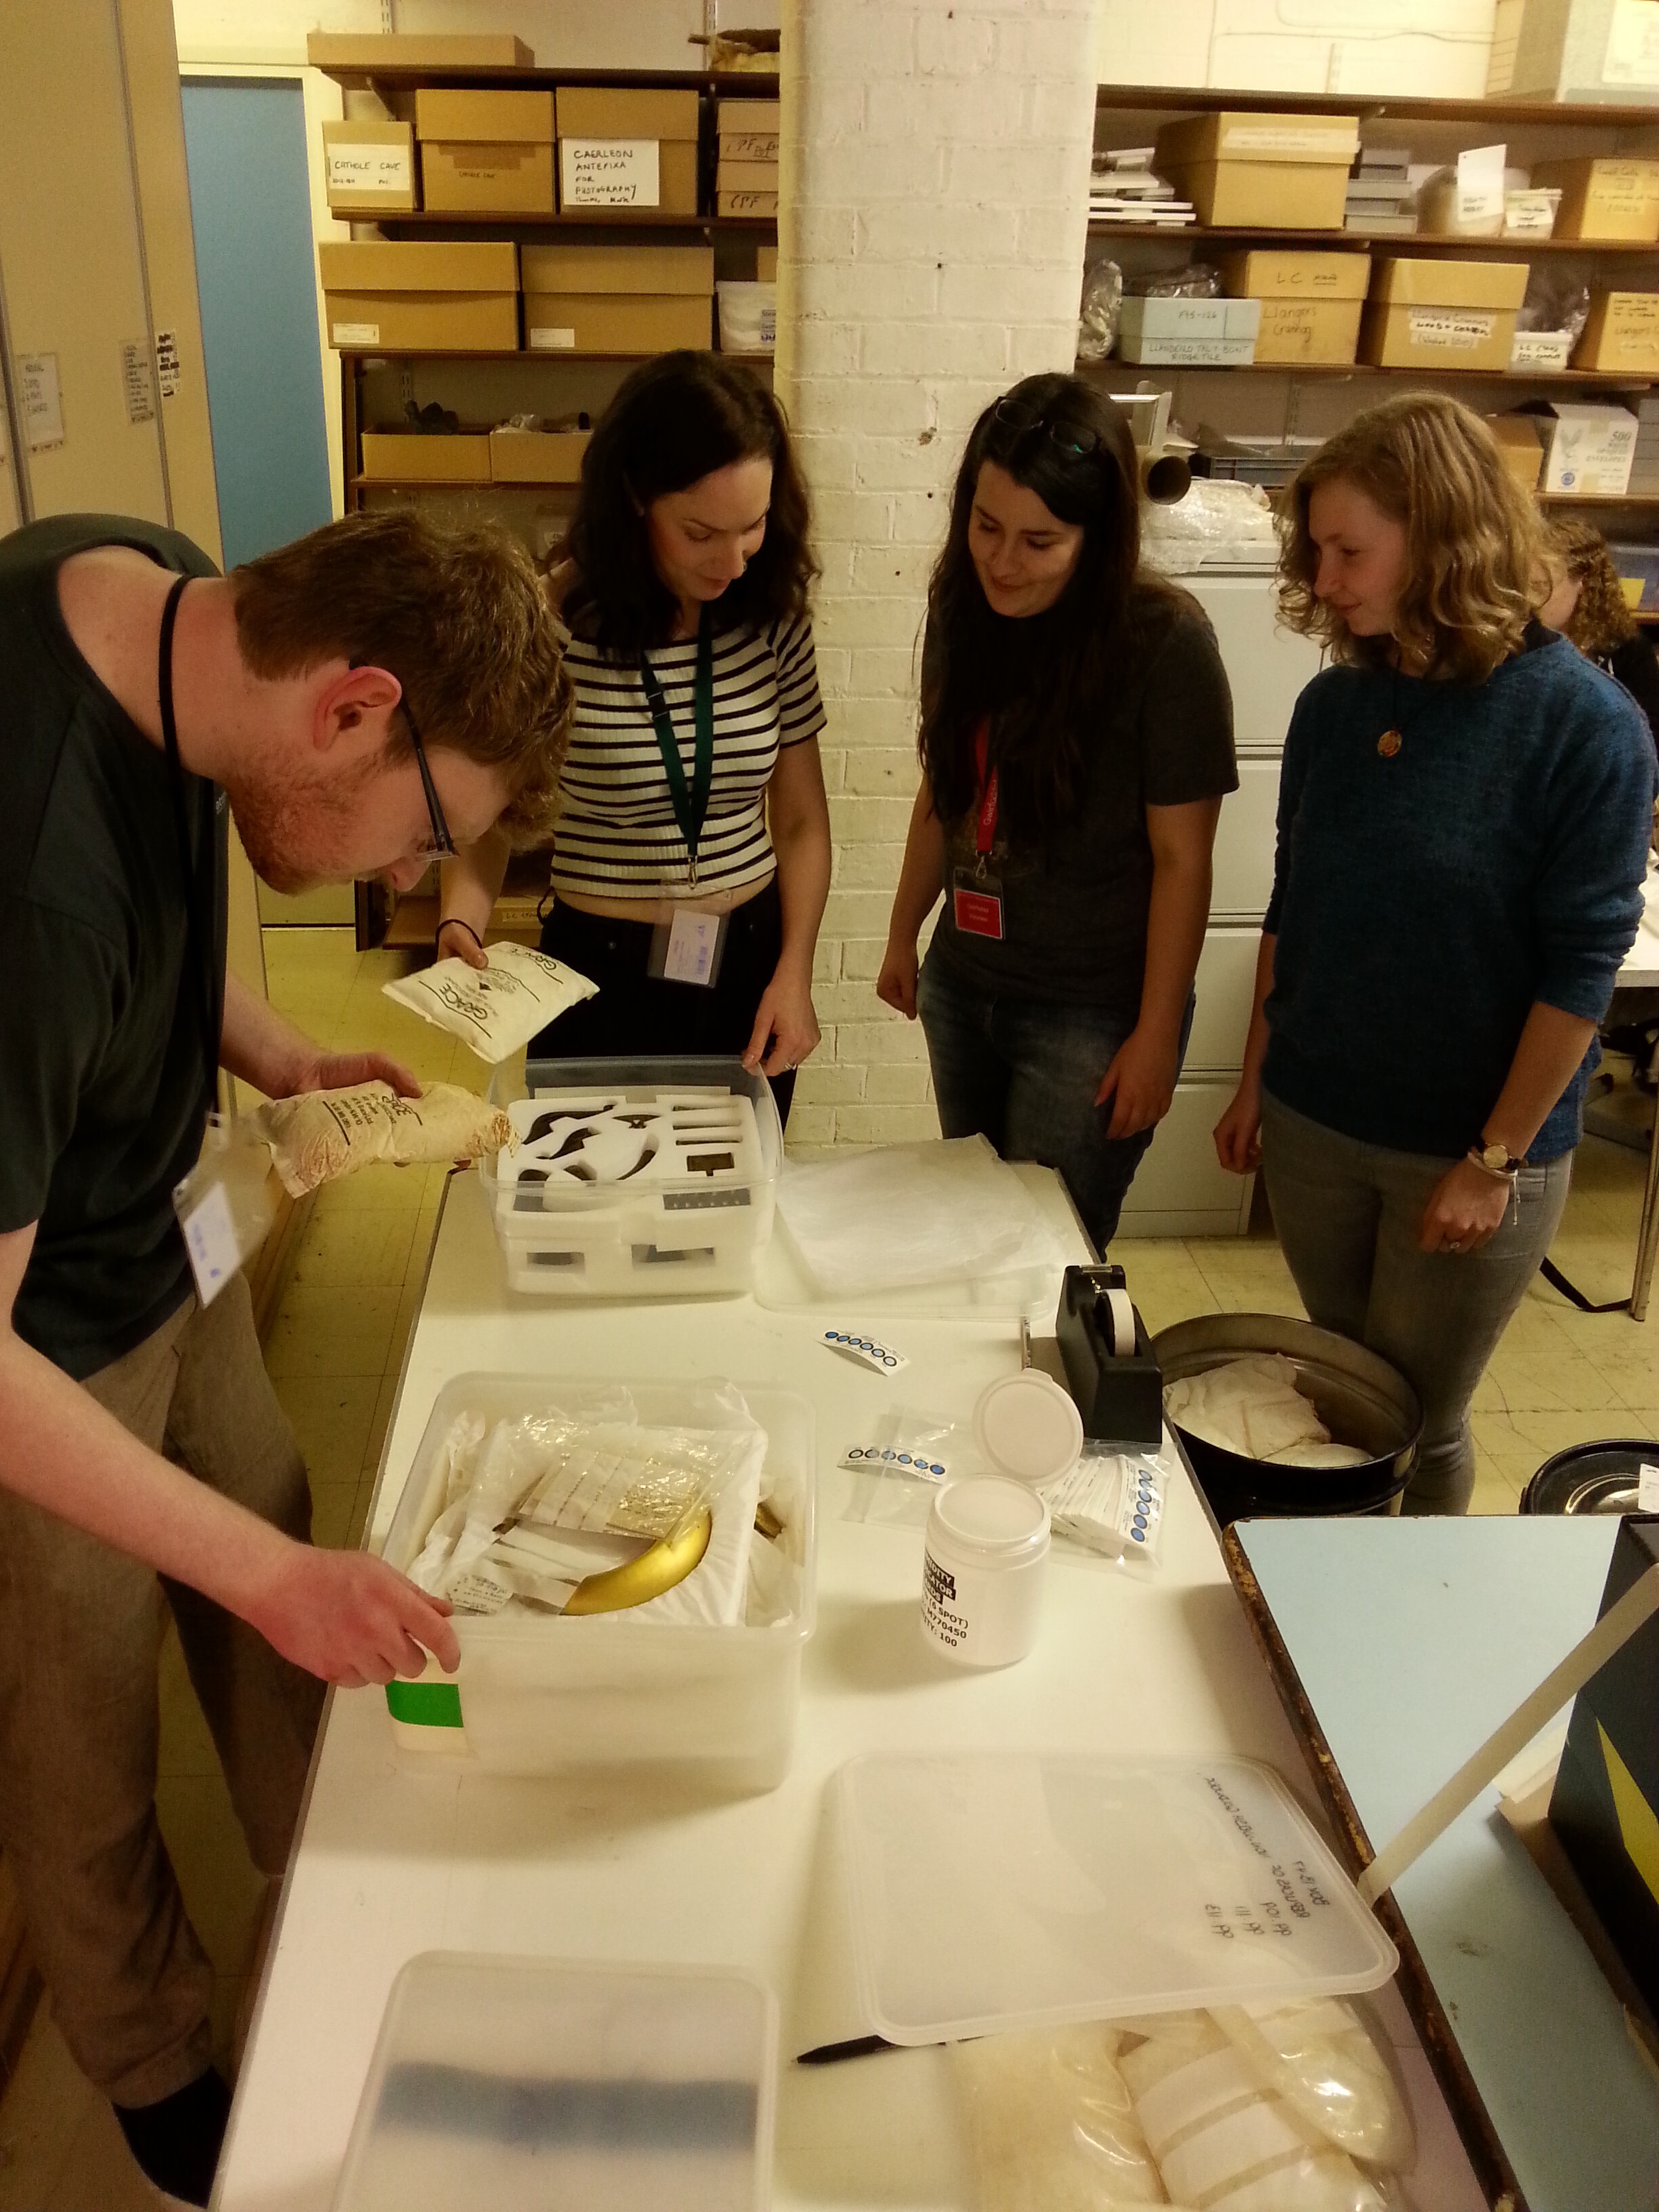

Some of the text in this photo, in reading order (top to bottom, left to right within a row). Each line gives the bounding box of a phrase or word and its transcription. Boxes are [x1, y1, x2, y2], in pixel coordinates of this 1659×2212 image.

[573, 150, 633, 159] CAERLEON
[334, 161, 401, 170] CATHOLE CAVE
[575, 162, 626, 171] ANTEFIXA
[575, 184, 636, 200] PHOTOGRAPHY
[439, 983, 488, 1019] GRACE
[939, 1607, 968, 1629] SPOT)
[940, 1632, 958, 1647] 100
